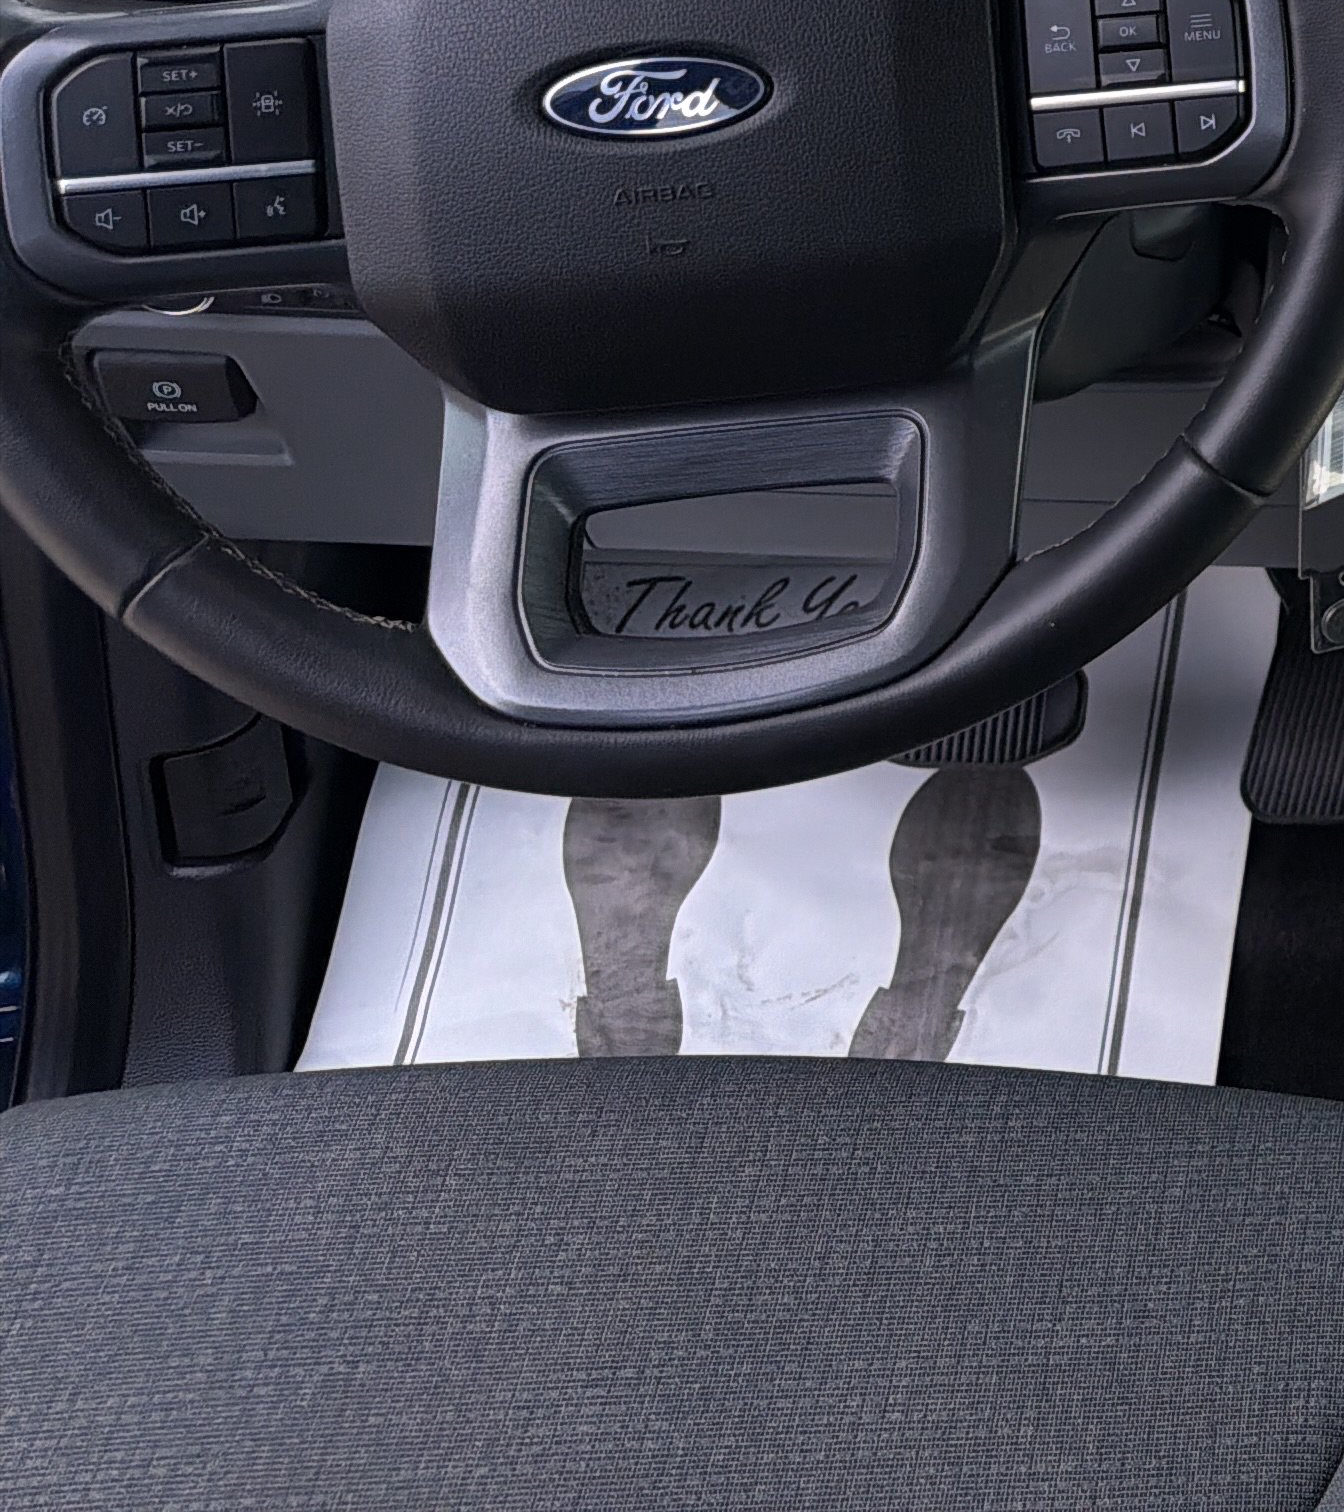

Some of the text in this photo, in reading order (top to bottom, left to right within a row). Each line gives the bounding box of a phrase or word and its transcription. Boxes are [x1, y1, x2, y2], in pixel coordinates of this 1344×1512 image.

[1119, 26, 1137, 37] OK
[1184, 29, 1221, 42] MENU
[1044, 42, 1077, 54] BACK
[588, 68, 722, 124] Ford
[147, 402, 198, 413] PULL ON
[614, 575, 791, 634] Thank
